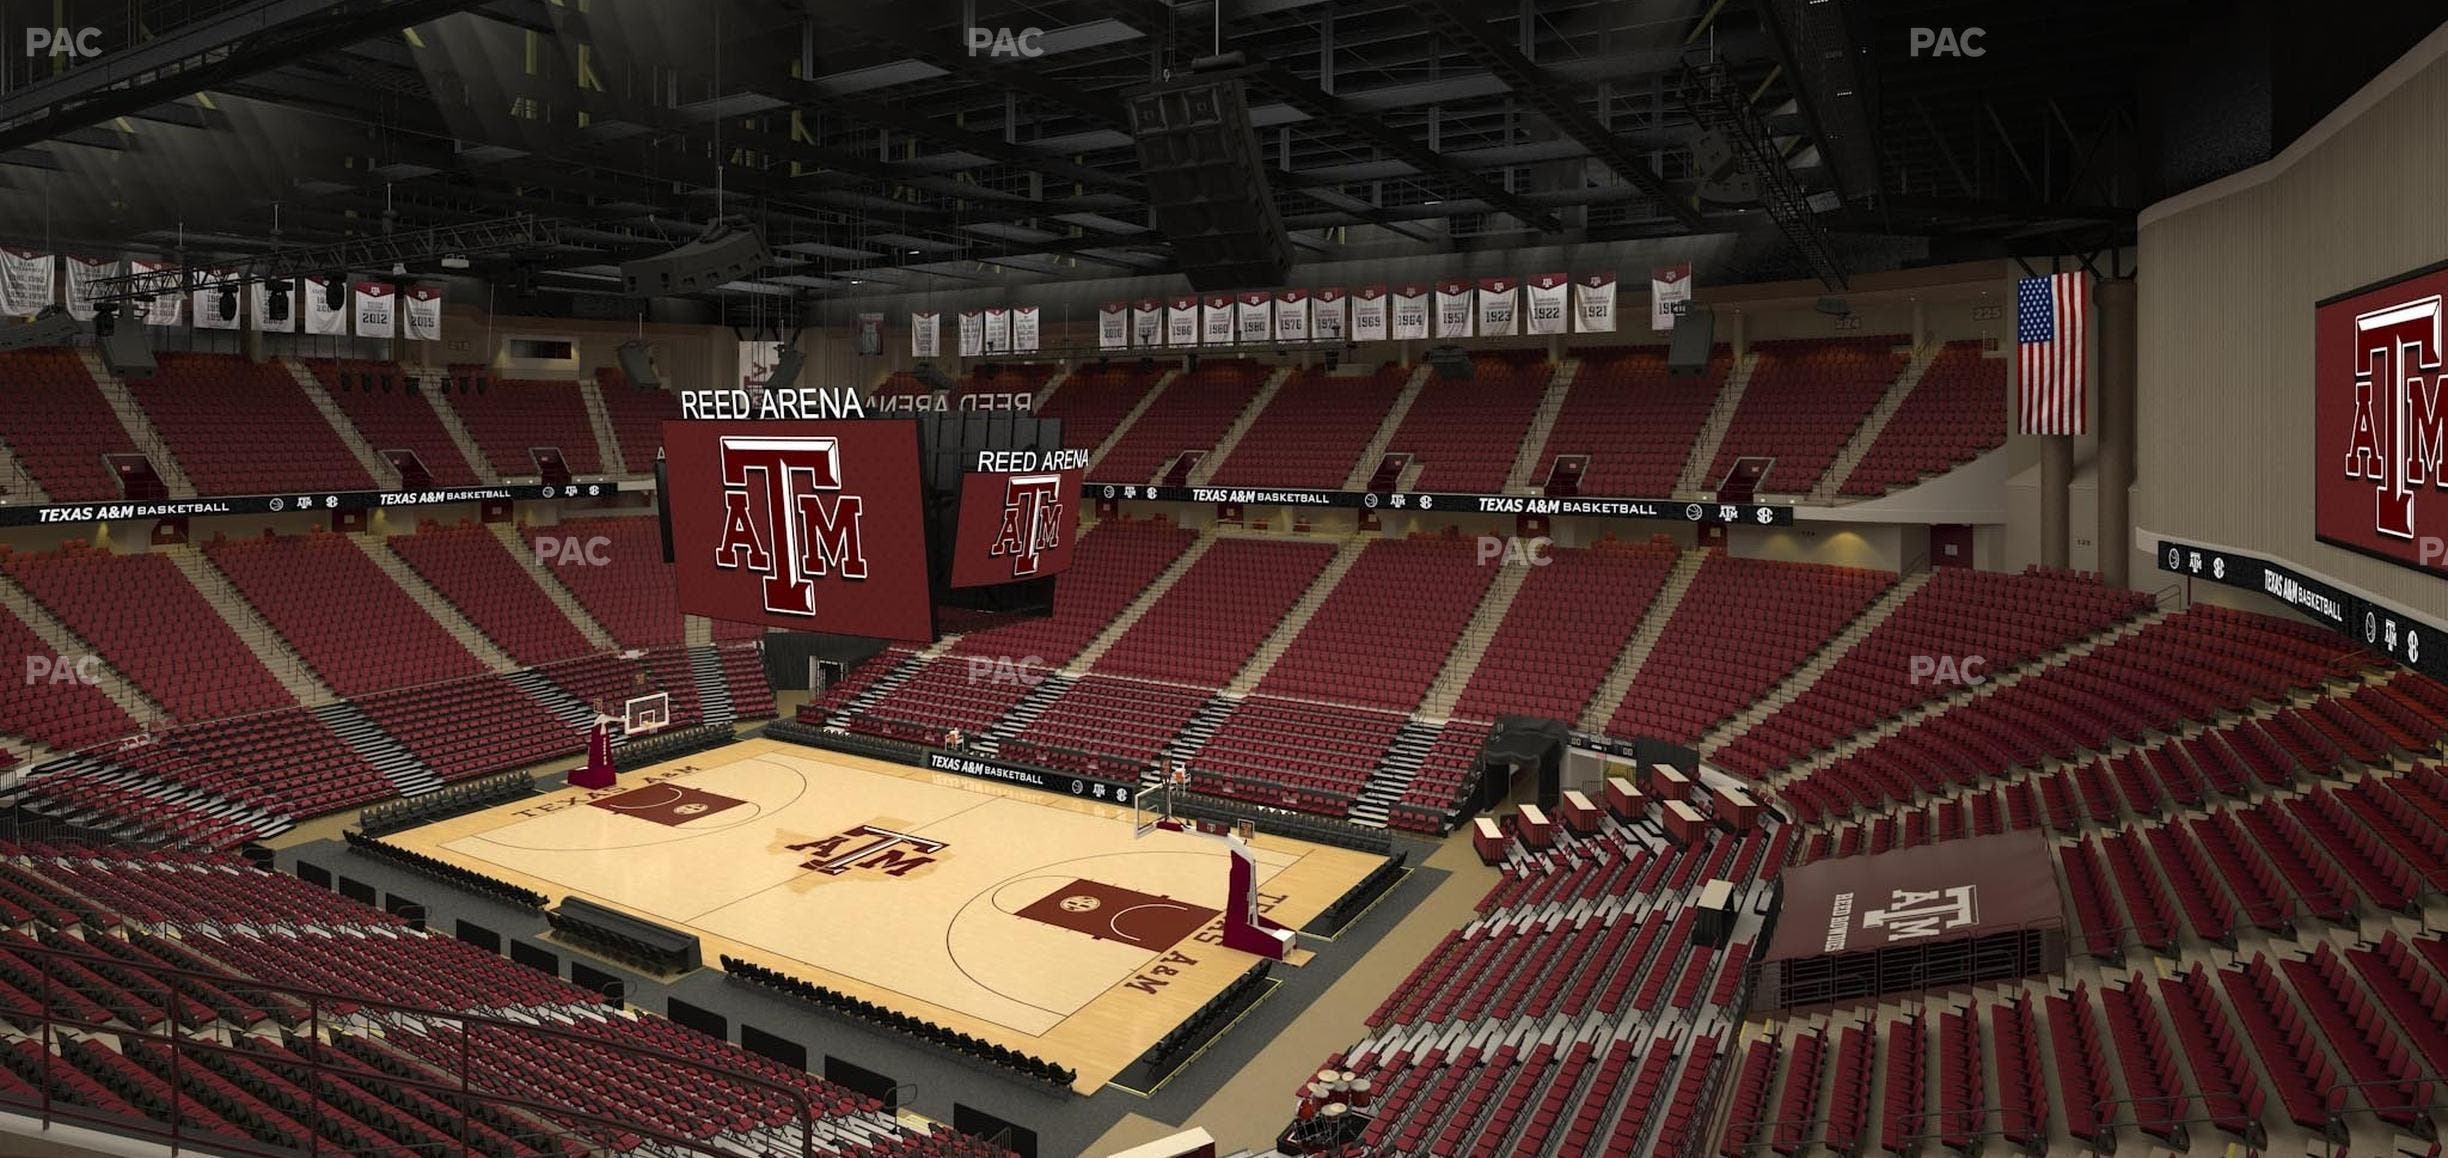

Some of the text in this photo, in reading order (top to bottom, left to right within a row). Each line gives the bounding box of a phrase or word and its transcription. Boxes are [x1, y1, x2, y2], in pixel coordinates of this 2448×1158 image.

[362, 312, 388, 325] 2012
[1442, 311, 1464, 324] 1951
[1485, 310, 1511, 323] 1923
[1533, 306, 1560, 320] 1922
[1582, 304, 1608, 319] 1921
[410, 315, 435, 328] 2015
[1280, 318, 1302, 331] 1976
[1357, 316, 1381, 328] 1969
[1397, 313, 1423, 327] 1964
[681, 386, 865, 420] REED ARENA
[977, 448, 1089, 473] REED ARENA
[380, 489, 511, 506] TEXAS A&M BASKETBALL
[1193, 488, 1330, 504] TEXAS A&M BASKETBALL
[39, 502, 230, 522] TEXAS A&M BASKETBALL
[1478, 497, 1658, 516] TEXAS A&M BASKETBALL
[2263, 568, 2343, 623] TEXAS A&M BASKETBALL
[931, 754, 1044, 785] TEXAS A&M BASKETBALL
[1831, 892, 1855, 917] REED
[1124, 950, 1199, 996] A&M
